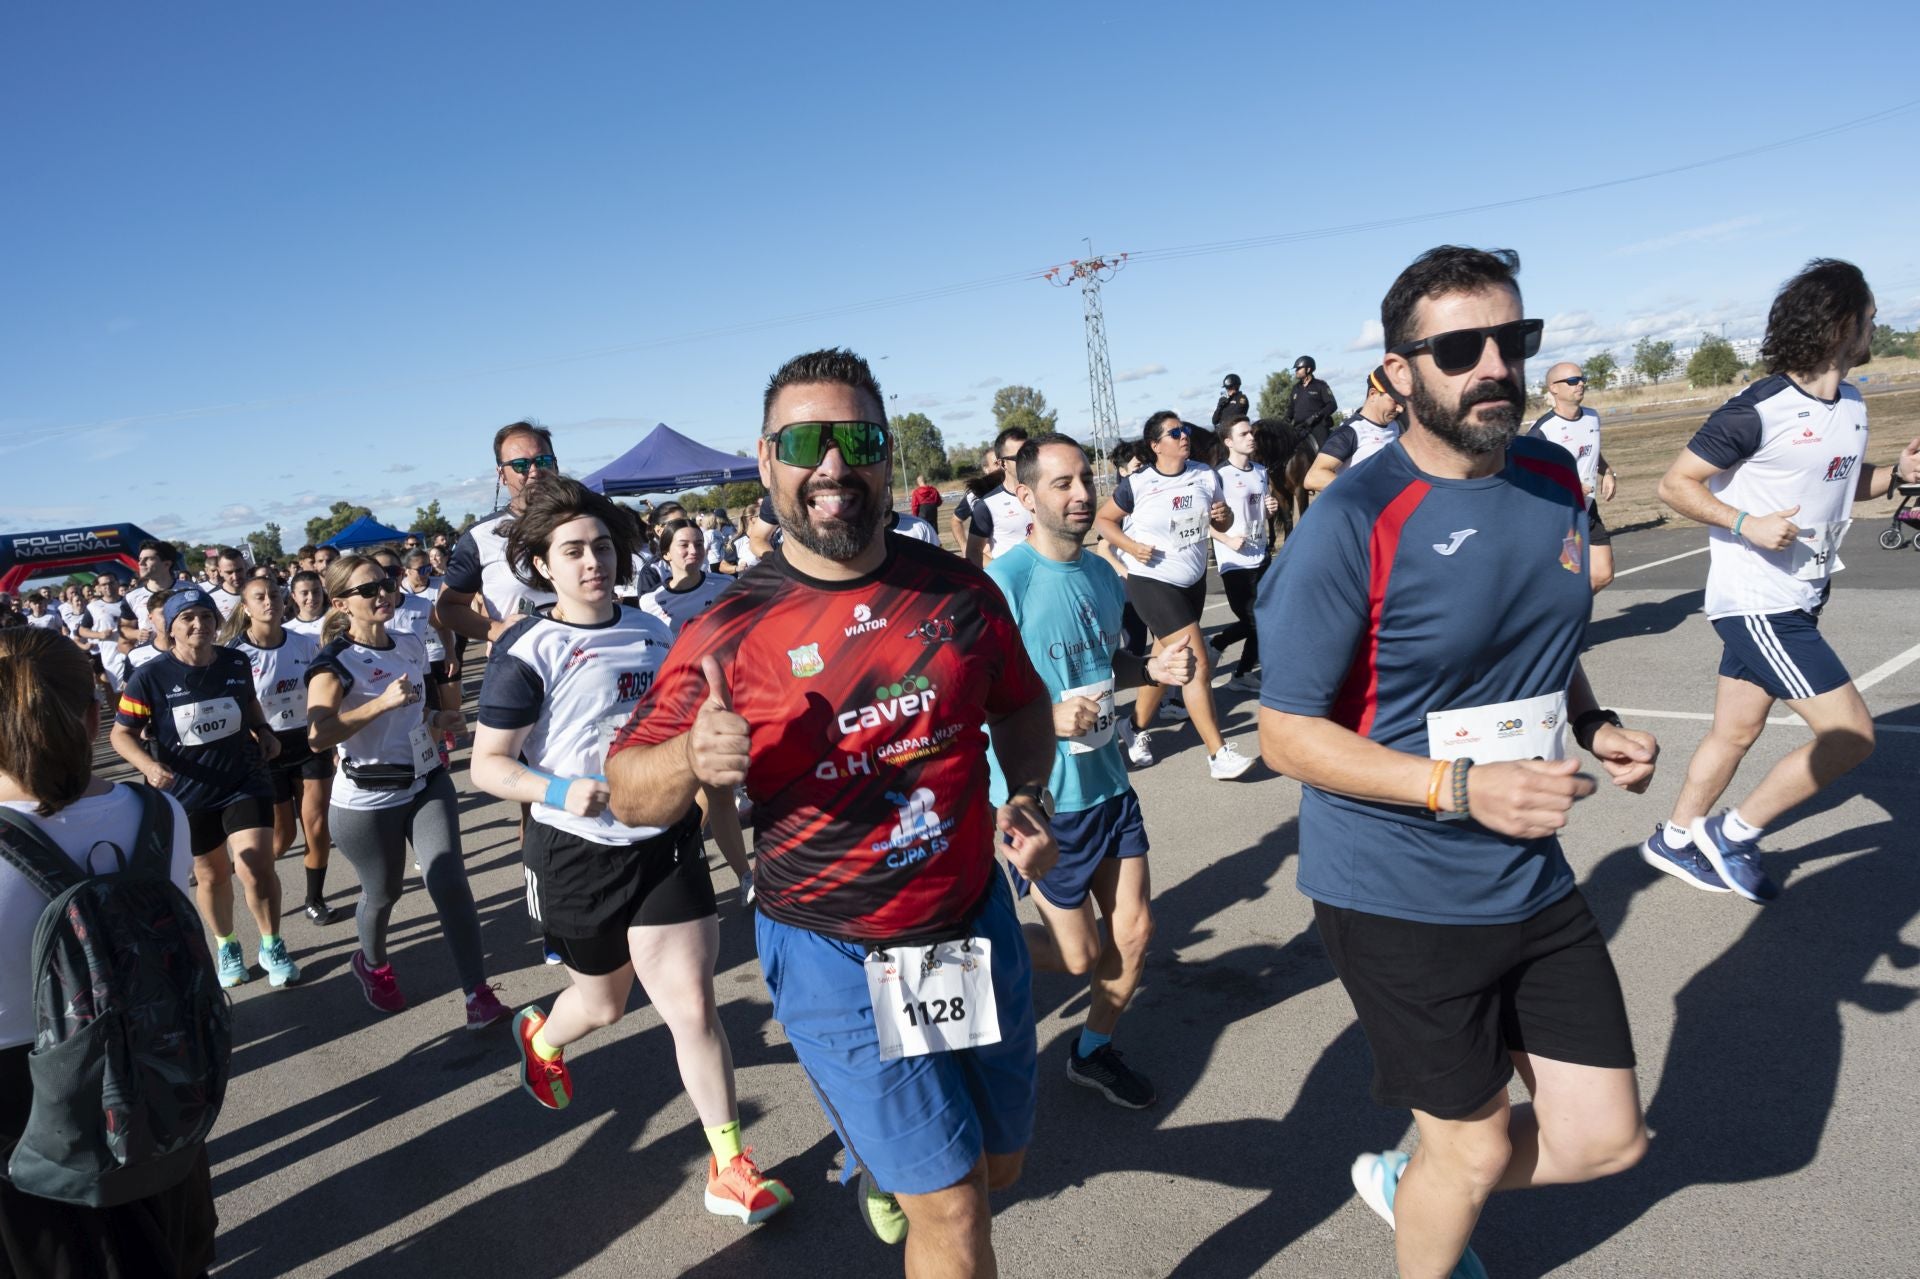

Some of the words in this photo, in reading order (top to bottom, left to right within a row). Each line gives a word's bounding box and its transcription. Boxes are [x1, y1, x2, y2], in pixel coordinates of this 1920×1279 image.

[13, 531, 97, 548] POLICIA
[1179, 528, 1200, 539] 1251
[15, 539, 121, 558] NACIONAL
[844, 618, 888, 638] VIATOR
[281, 709, 294, 719] 61
[837, 689, 936, 734] caver
[194, 718, 227, 735] 1007
[877, 736, 930, 759] GASPAR
[902, 996, 966, 1027] 1128
